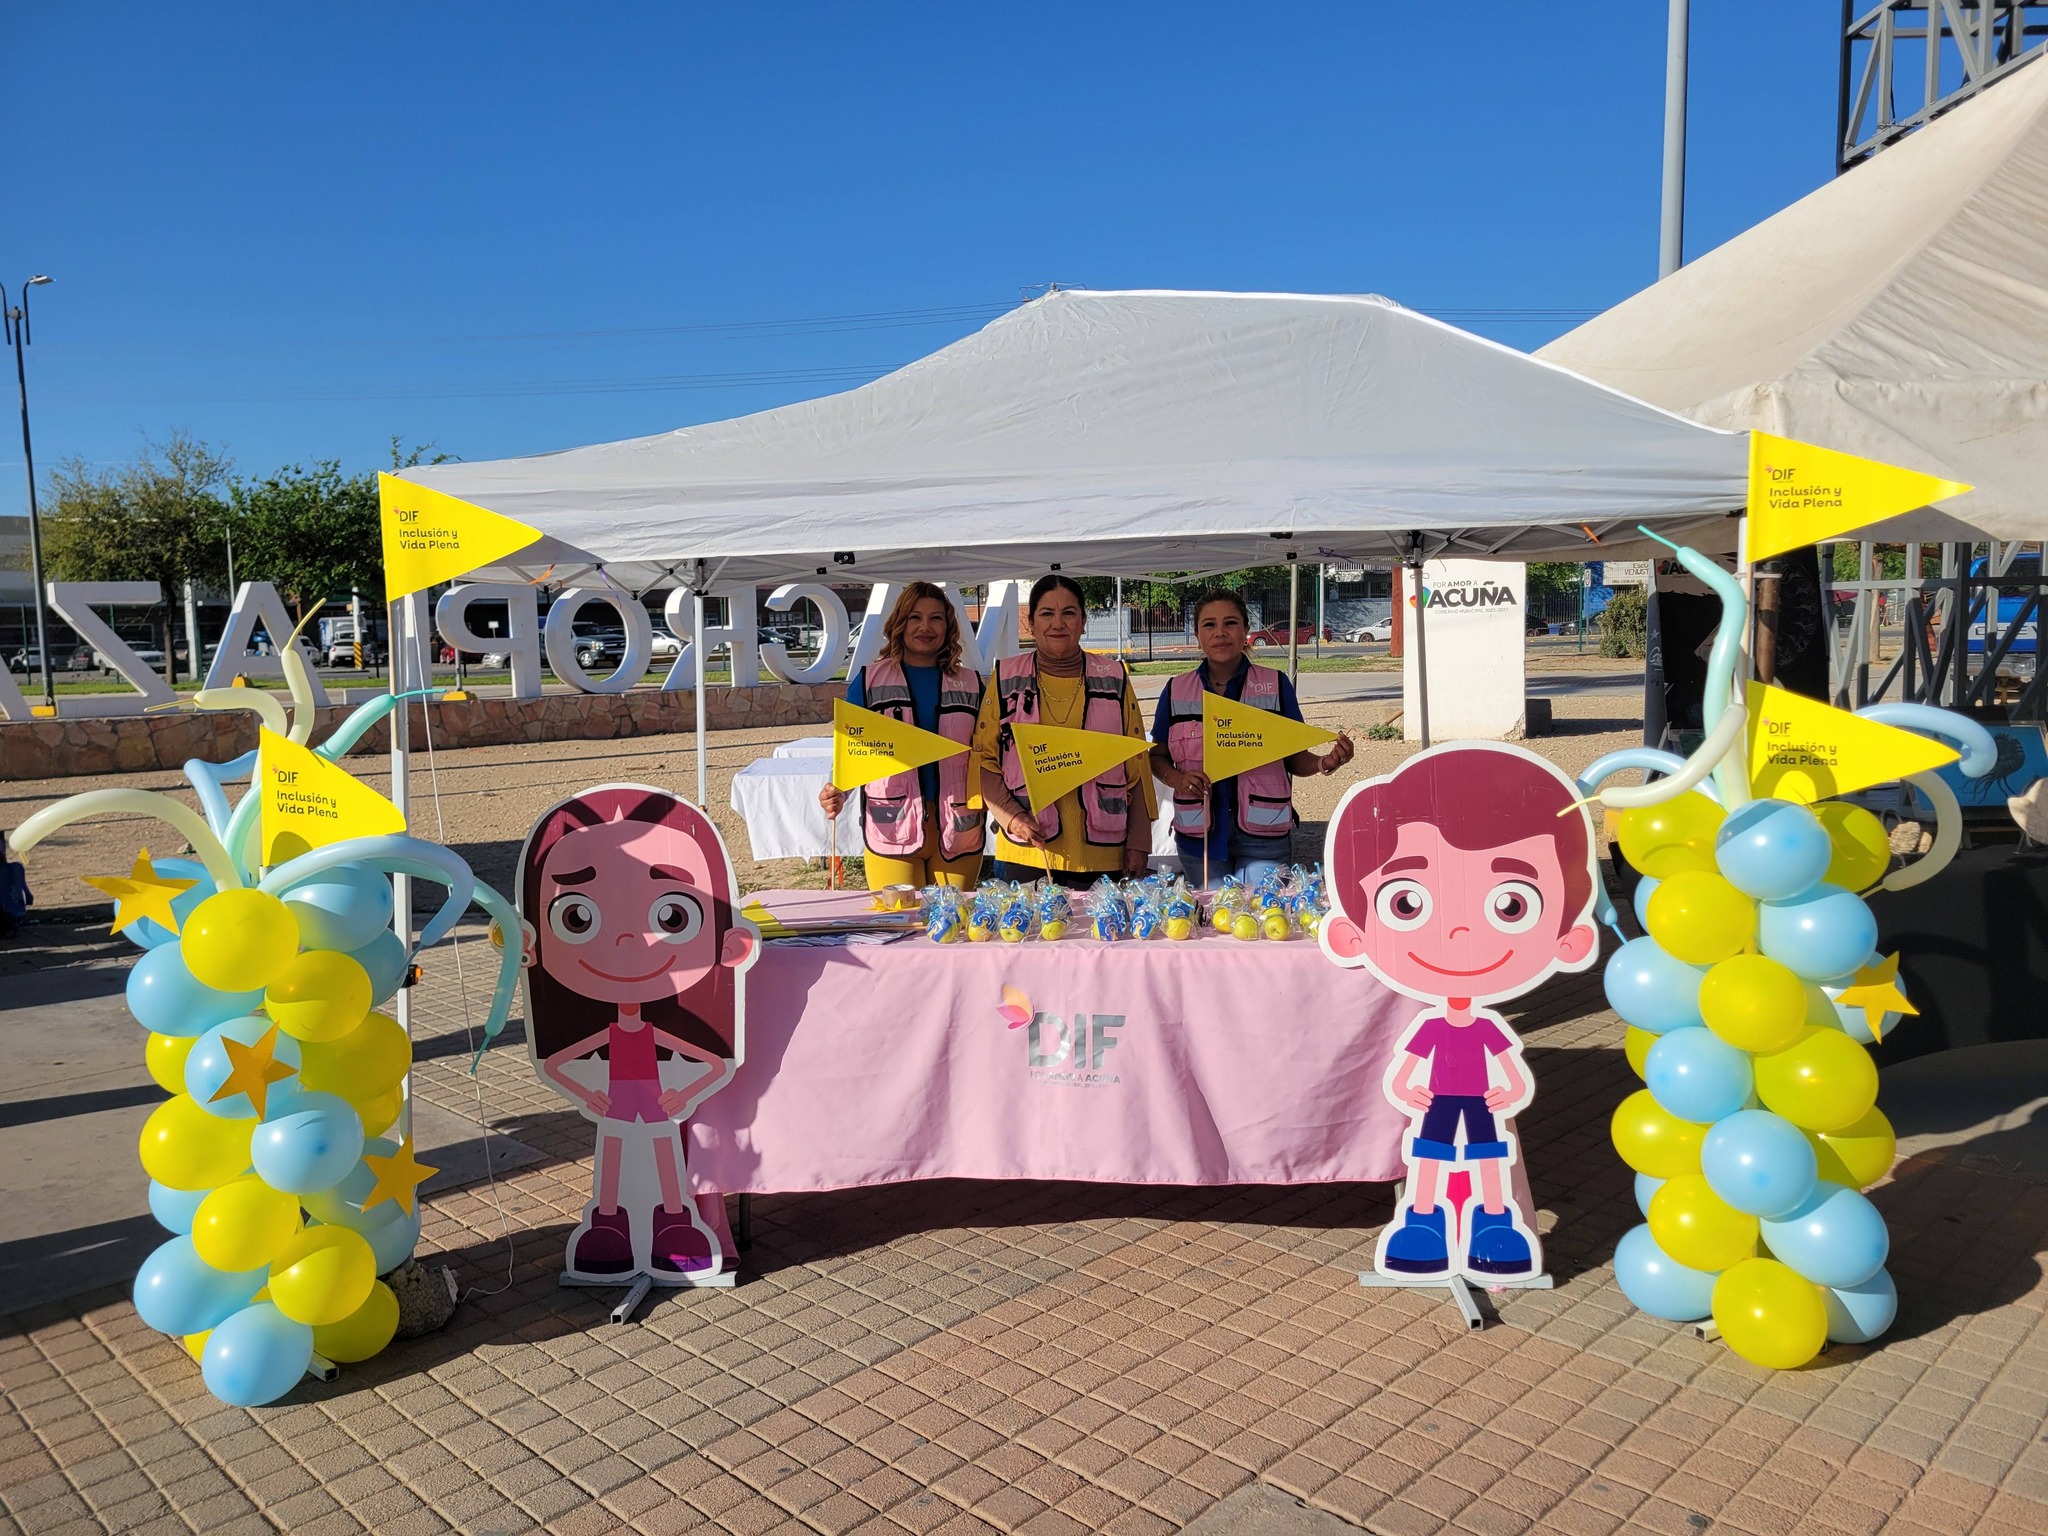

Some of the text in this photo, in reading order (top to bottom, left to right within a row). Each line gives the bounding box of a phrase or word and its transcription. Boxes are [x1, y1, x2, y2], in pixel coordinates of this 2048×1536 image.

[1772, 468, 1796, 481] DIF
[1769, 485, 1842, 497] Inclusión y
[1769, 498, 1843, 509] Vida Plena
[399, 510, 419, 522] DIF
[399, 528, 458, 539] Inclusión y
[399, 540, 460, 549] Vida Plena
[1427, 580, 1517, 609] ACUÑA
[1254, 682, 1274, 693] DIF
[1217, 718, 1233, 728] DIF
[1769, 722, 1792, 734] DIF
[849, 726, 865, 736] DIF
[1216, 731, 1255, 739] Inclusión
[847, 740, 887, 748] Inclusión
[1033, 743, 1047, 754] DIF
[1767, 741, 1837, 755] Inclusión y
[1034, 752, 1073, 766] Inclusión
[1767, 754, 1838, 766] Vida Plena
[1036, 759, 1083, 773] Vida Plena
[278, 770, 299, 783] DIF
[277, 790, 336, 809] Inclusión y
[277, 802, 339, 819] Vida Plena
[1028, 1012, 1126, 1070] DIF
